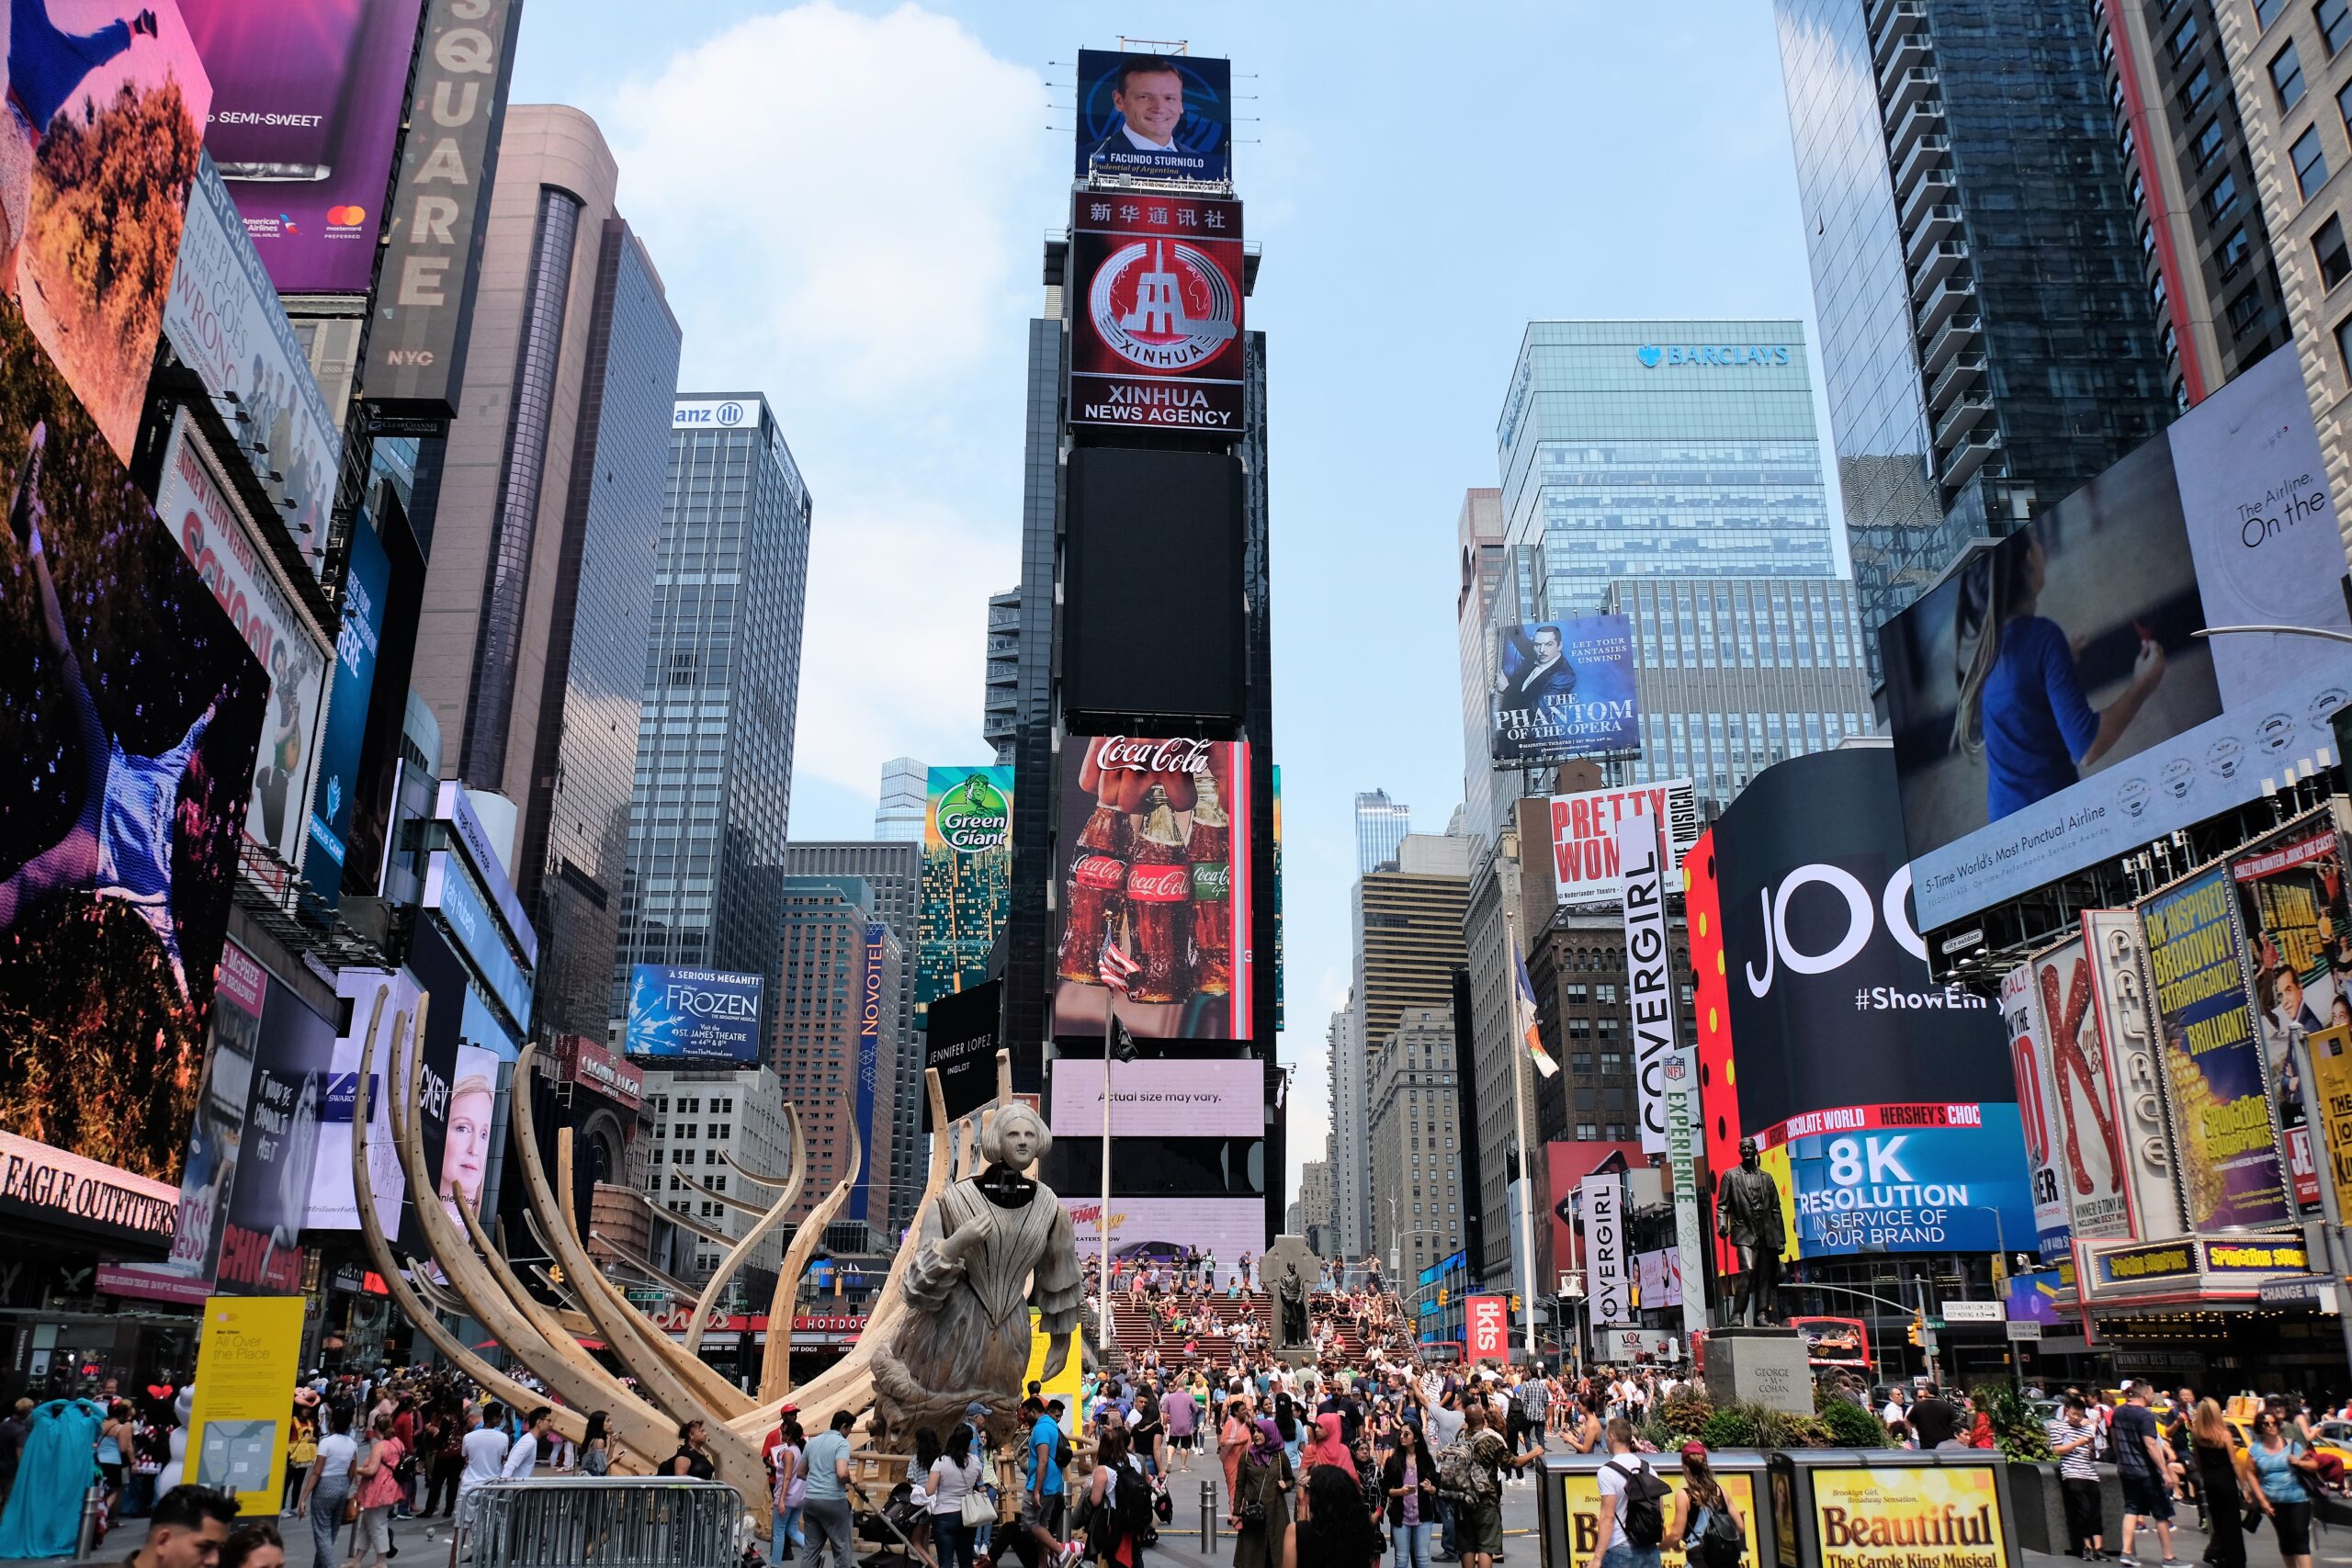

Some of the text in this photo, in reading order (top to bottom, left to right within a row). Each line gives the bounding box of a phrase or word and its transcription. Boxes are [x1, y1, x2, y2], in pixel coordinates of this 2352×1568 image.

[219, 111, 322, 127] SEMI-SWEET
[1110, 152, 1204, 168] FACUNDO STURNIOLO
[1131, 164, 1140, 175] of
[1140, 166, 1179, 175] Argentina
[243, 218, 279, 226] American
[1090, 202, 1227, 230] 新华通讯社
[197, 207, 250, 314] THE PLAY
[186, 225, 213, 287] THAT
[212, 281, 249, 358] GOES
[198, 153, 228, 217] LAST
[225, 209, 266, 296] CHANCE!
[261, 289, 288, 342] MUST
[315, 404, 333, 443] AUG
[327, 434, 340, 457] 25
[176, 256, 239, 392] WRONG
[387, 350, 434, 367] NYC
[1119, 338, 1204, 365] XINHUA
[1668, 345, 1790, 366] BARCLAYS
[1108, 384, 1209, 409] XINHUA
[1085, 404, 1231, 425] NEWS AGENCY
[2236, 473, 2313, 522] The Airline,
[177, 446, 204, 503] ANDREW
[205, 490, 229, 544] LLOYD
[228, 526, 254, 575] WEBBER
[2242, 491, 2325, 548] On the
[1571, 645, 1627, 657] FANTASIES
[1573, 637, 1625, 649] LET YOUR
[1577, 654, 1622, 664] UNWIND
[1544, 693, 1579, 707] THE
[1493, 699, 1634, 731] PHANTOM
[1507, 720, 1623, 741] OF THE OPERA
[1097, 735, 1214, 773] Coca-Cola
[944, 811, 1006, 829] Green
[1552, 788, 1666, 842] PRETTY
[1668, 784, 1698, 843] MUSICAL
[951, 829, 1008, 847] Giant
[2302, 840, 2315, 858] THE
[1926, 806, 2106, 894] 5-Time World's Most Punctual Airline
[1565, 887, 1616, 898] Nederlander Theatre
[2146, 880, 2228, 949] AN INSPIRED
[1945, 933, 1980, 950] city outdoor
[2152, 917, 2234, 987] BROADWAY
[228, 946, 260, 987] MCPHEE
[678, 971, 716, 982] SERIOUS
[227, 971, 257, 1006] BROADWAY
[861, 935, 884, 1036] NOVOTEL
[1625, 852, 1670, 1134] COVERGIRL
[2159, 958, 2242, 1015] EXTRAVAGANZA!
[666, 985, 757, 1018] FROZEN
[679, 1029, 747, 1042] ST. JAMES THEATRE
[2187, 1005, 2252, 1056] BRILLIANT!
[683, 1048, 733, 1057] FrozenTheMusical.com
[929, 1033, 992, 1065] JENNIFER LOPEZ
[2108, 929, 2168, 1167] PALACE
[946, 1061, 971, 1076] INGLOT
[1666, 1066, 1683, 1078] NFL
[259, 1069, 293, 1106] IT WOULD BE
[1098, 1092, 1221, 1103] Actual size may vary.
[1880, 1105, 1981, 1126] HERSHEY'S CHOC
[2330, 1094, 2352, 1114] THE
[254, 1103, 288, 1135] CRIMINAL TO
[1786, 1108, 1865, 1139] CHOCOLATE WORLD
[2201, 1094, 2270, 1138] SPONGEBOB
[257, 1134, 279, 1162] MISS IT
[1667, 1092, 1696, 1204] EXPERIENCE
[1828, 1135, 1913, 1185] 8K
[2, 1155, 75, 1208] EAGLE
[76, 1178, 179, 1236] OUTFITTERS
[1801, 1184, 1968, 1214] RESOLUTION
[2102, 1198, 2117, 1213] TONY
[1813, 1209, 1948, 1230] IN SERVICE OF
[2077, 1216, 2101, 1228] INCLUDING
[2101, 1213, 2115, 1223] BEST
[1817, 1227, 1945, 1247] YOUR BRAND
[219, 1224, 305, 1295] CHICAGO
[2210, 1247, 2272, 1267] SPONGEBOB
[2260, 1285, 2304, 1301] CHANGE
[1476, 1301, 1499, 1351] tkts
[213, 1348, 270, 1359] the Place
[215, 1336, 261, 1348] All Over
[1755, 1368, 1789, 1377] GEORGE
[1758, 1384, 1789, 1393] COHAN
[1832, 1488, 1879, 1497] Brooklyn Girl.
[1848, 1496, 1882, 1505] Broadway
[1822, 1503, 1995, 1548] Beautiful
[1826, 1551, 1997, 1568] The Carole King Musical
